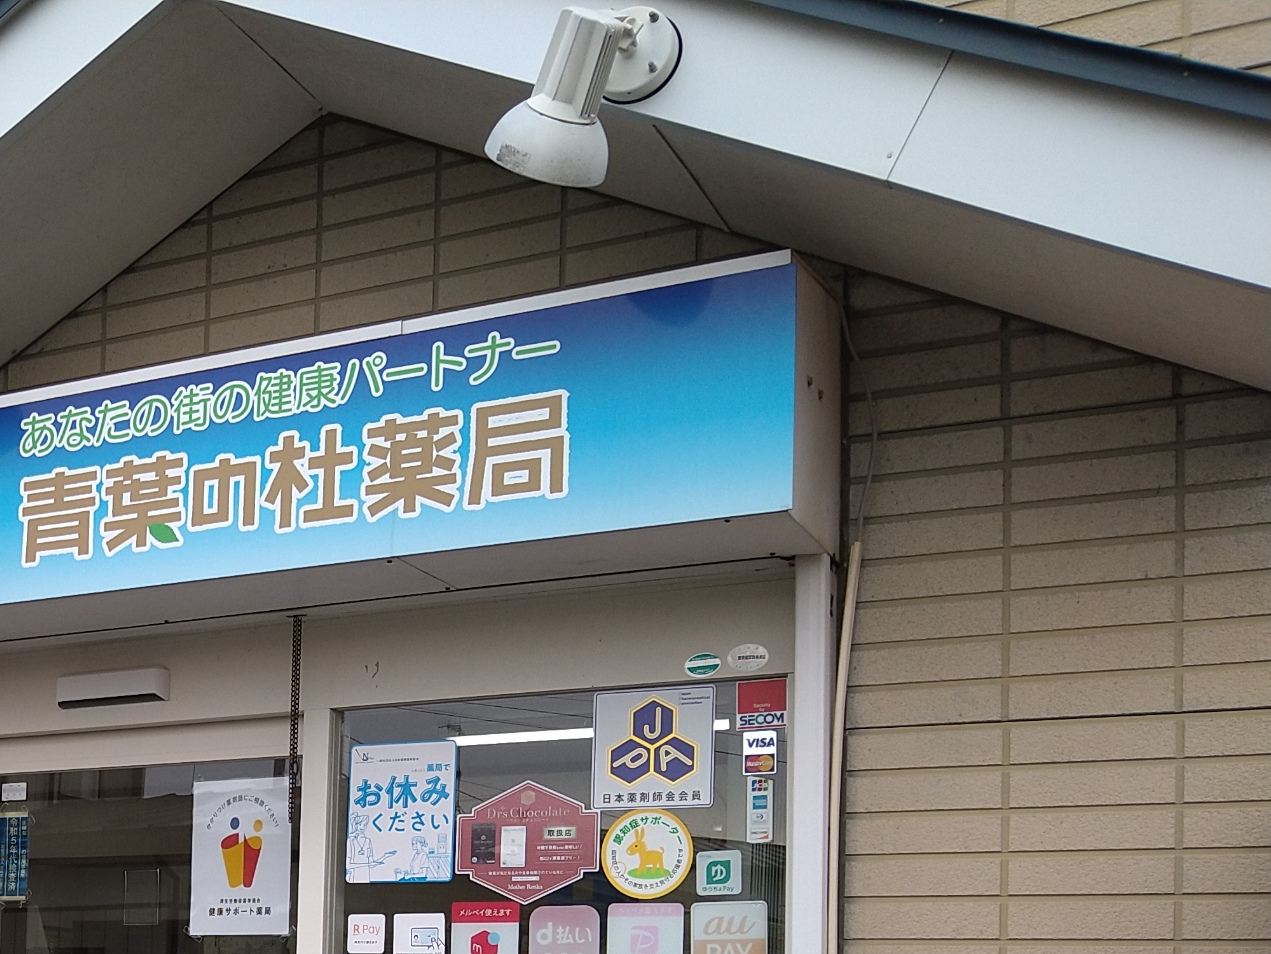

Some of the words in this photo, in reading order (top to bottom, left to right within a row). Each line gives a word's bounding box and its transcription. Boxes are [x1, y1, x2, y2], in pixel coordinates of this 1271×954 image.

[21, 333, 560, 456] あなたの街の健康パートナー
[21, 391, 569, 566] 青葉の杜薬局
[740, 712, 784, 726] SECOM
[746, 737, 775, 748] VISA
[354, 775, 450, 809] お休み
[752, 780, 769, 791] JCB
[602, 790, 702, 804] 日本薬剤師会会員
[510, 806, 570, 819] Chocolate
[372, 811, 449, 832] ください
[546, 829, 572, 838] 取扱店
[613, 816, 683, 845] 認知症サポーター
[209, 907, 271, 917] 健康サポート薬局
[459, 909, 512, 917] メルペイ使えます
[362, 924, 380, 936] Pay
[703, 915, 756, 935] au
[536, 922, 593, 945] d払い
